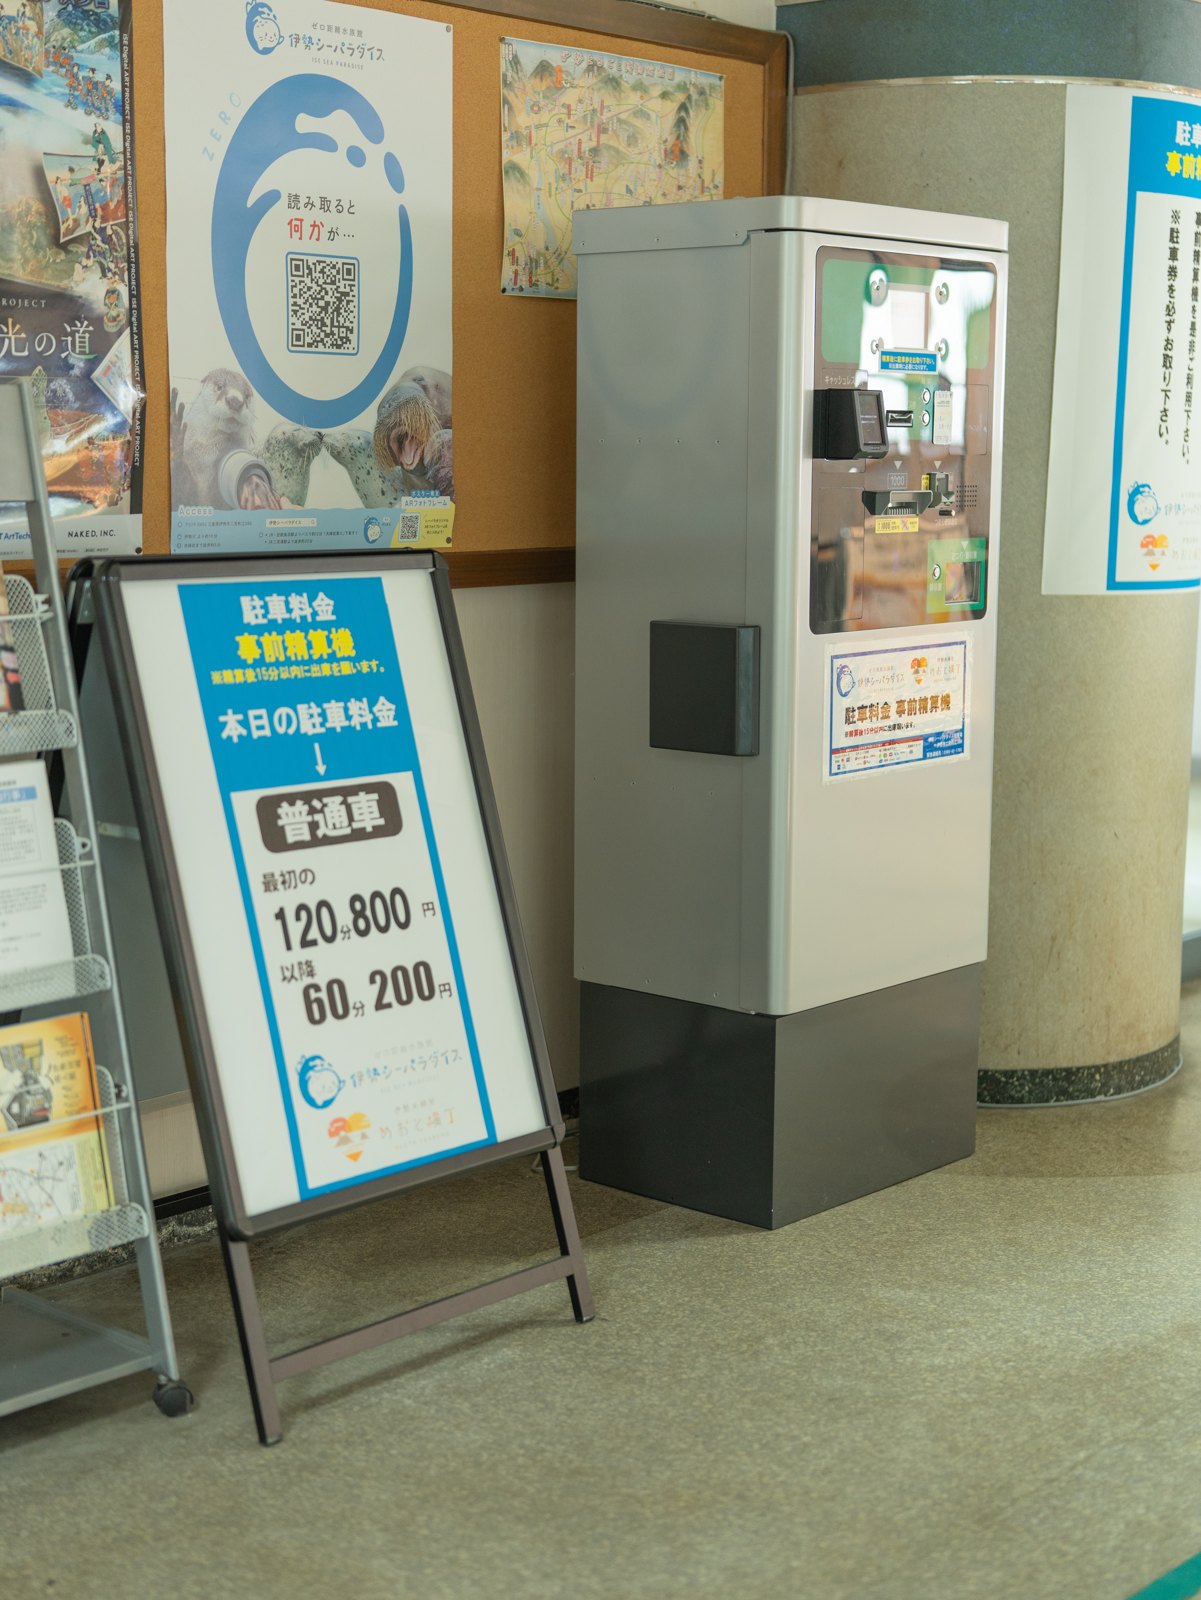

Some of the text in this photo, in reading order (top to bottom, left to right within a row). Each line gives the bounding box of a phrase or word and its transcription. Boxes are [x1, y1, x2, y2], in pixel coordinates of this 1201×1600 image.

[289, 33, 385, 61] 伊勢シーパラダイス
[202, 92, 241, 161] ZERO
[288, 193, 355, 214] 読み取ると
[0, 297, 46, 309] ROJECT
[0, 317, 97, 359] 光の道
[67, 529, 116, 538] NAKED, INC.
[240, 592, 336, 625] 駐車料金
[235, 628, 356, 664] 事前精算機
[218, 696, 398, 743] 本日の駐車料金
[845, 693, 951, 725] 駐車料金 事前精算機
[277, 791, 385, 844] 普通車
[262, 868, 316, 893] 最初の
[280, 959, 317, 984] 以降
